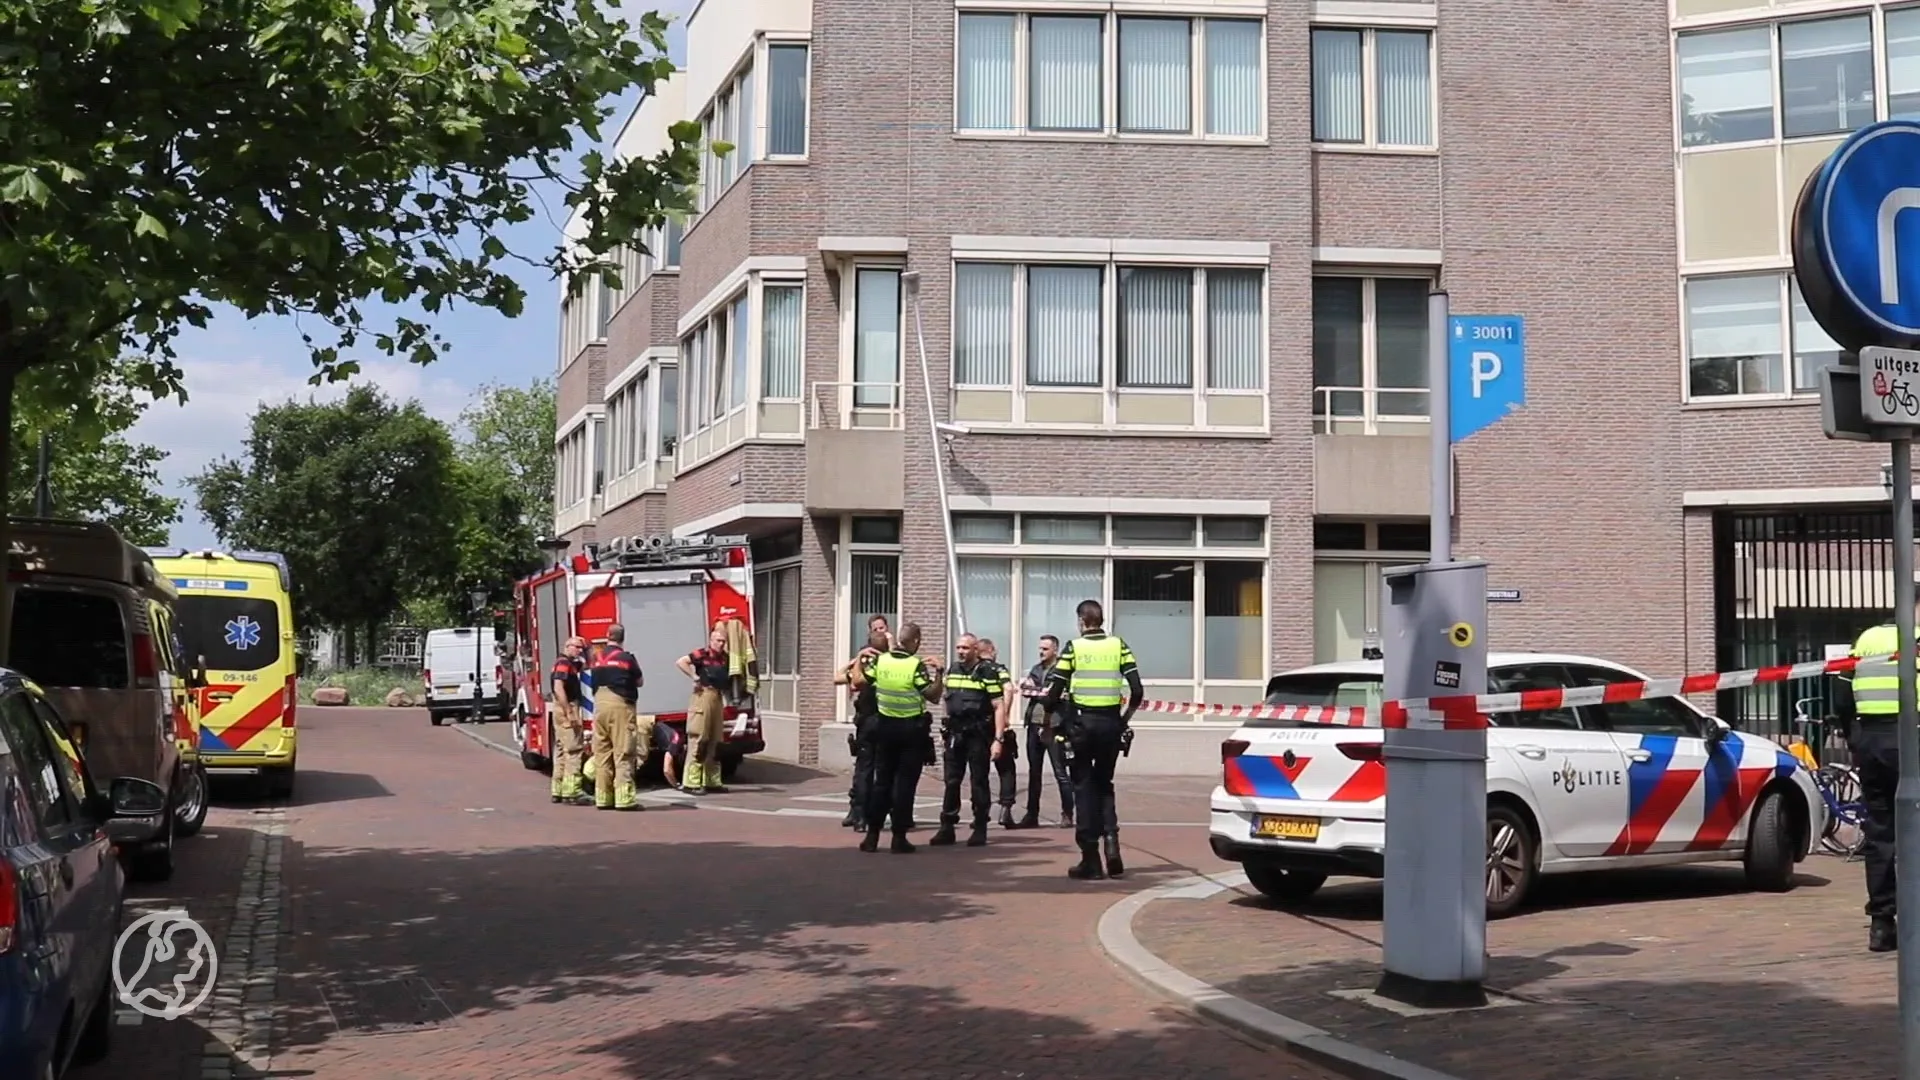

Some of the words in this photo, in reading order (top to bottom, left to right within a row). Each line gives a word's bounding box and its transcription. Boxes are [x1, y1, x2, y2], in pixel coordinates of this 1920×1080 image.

[1472, 326, 1512, 339] 30011
[1875, 356, 1919, 376] uitgez
[1472, 351, 1502, 398] P
[223, 673, 258, 682] 09-146
[1269, 731, 1320, 740] POLITIE
[1553, 770, 1621, 793] POLITIE
